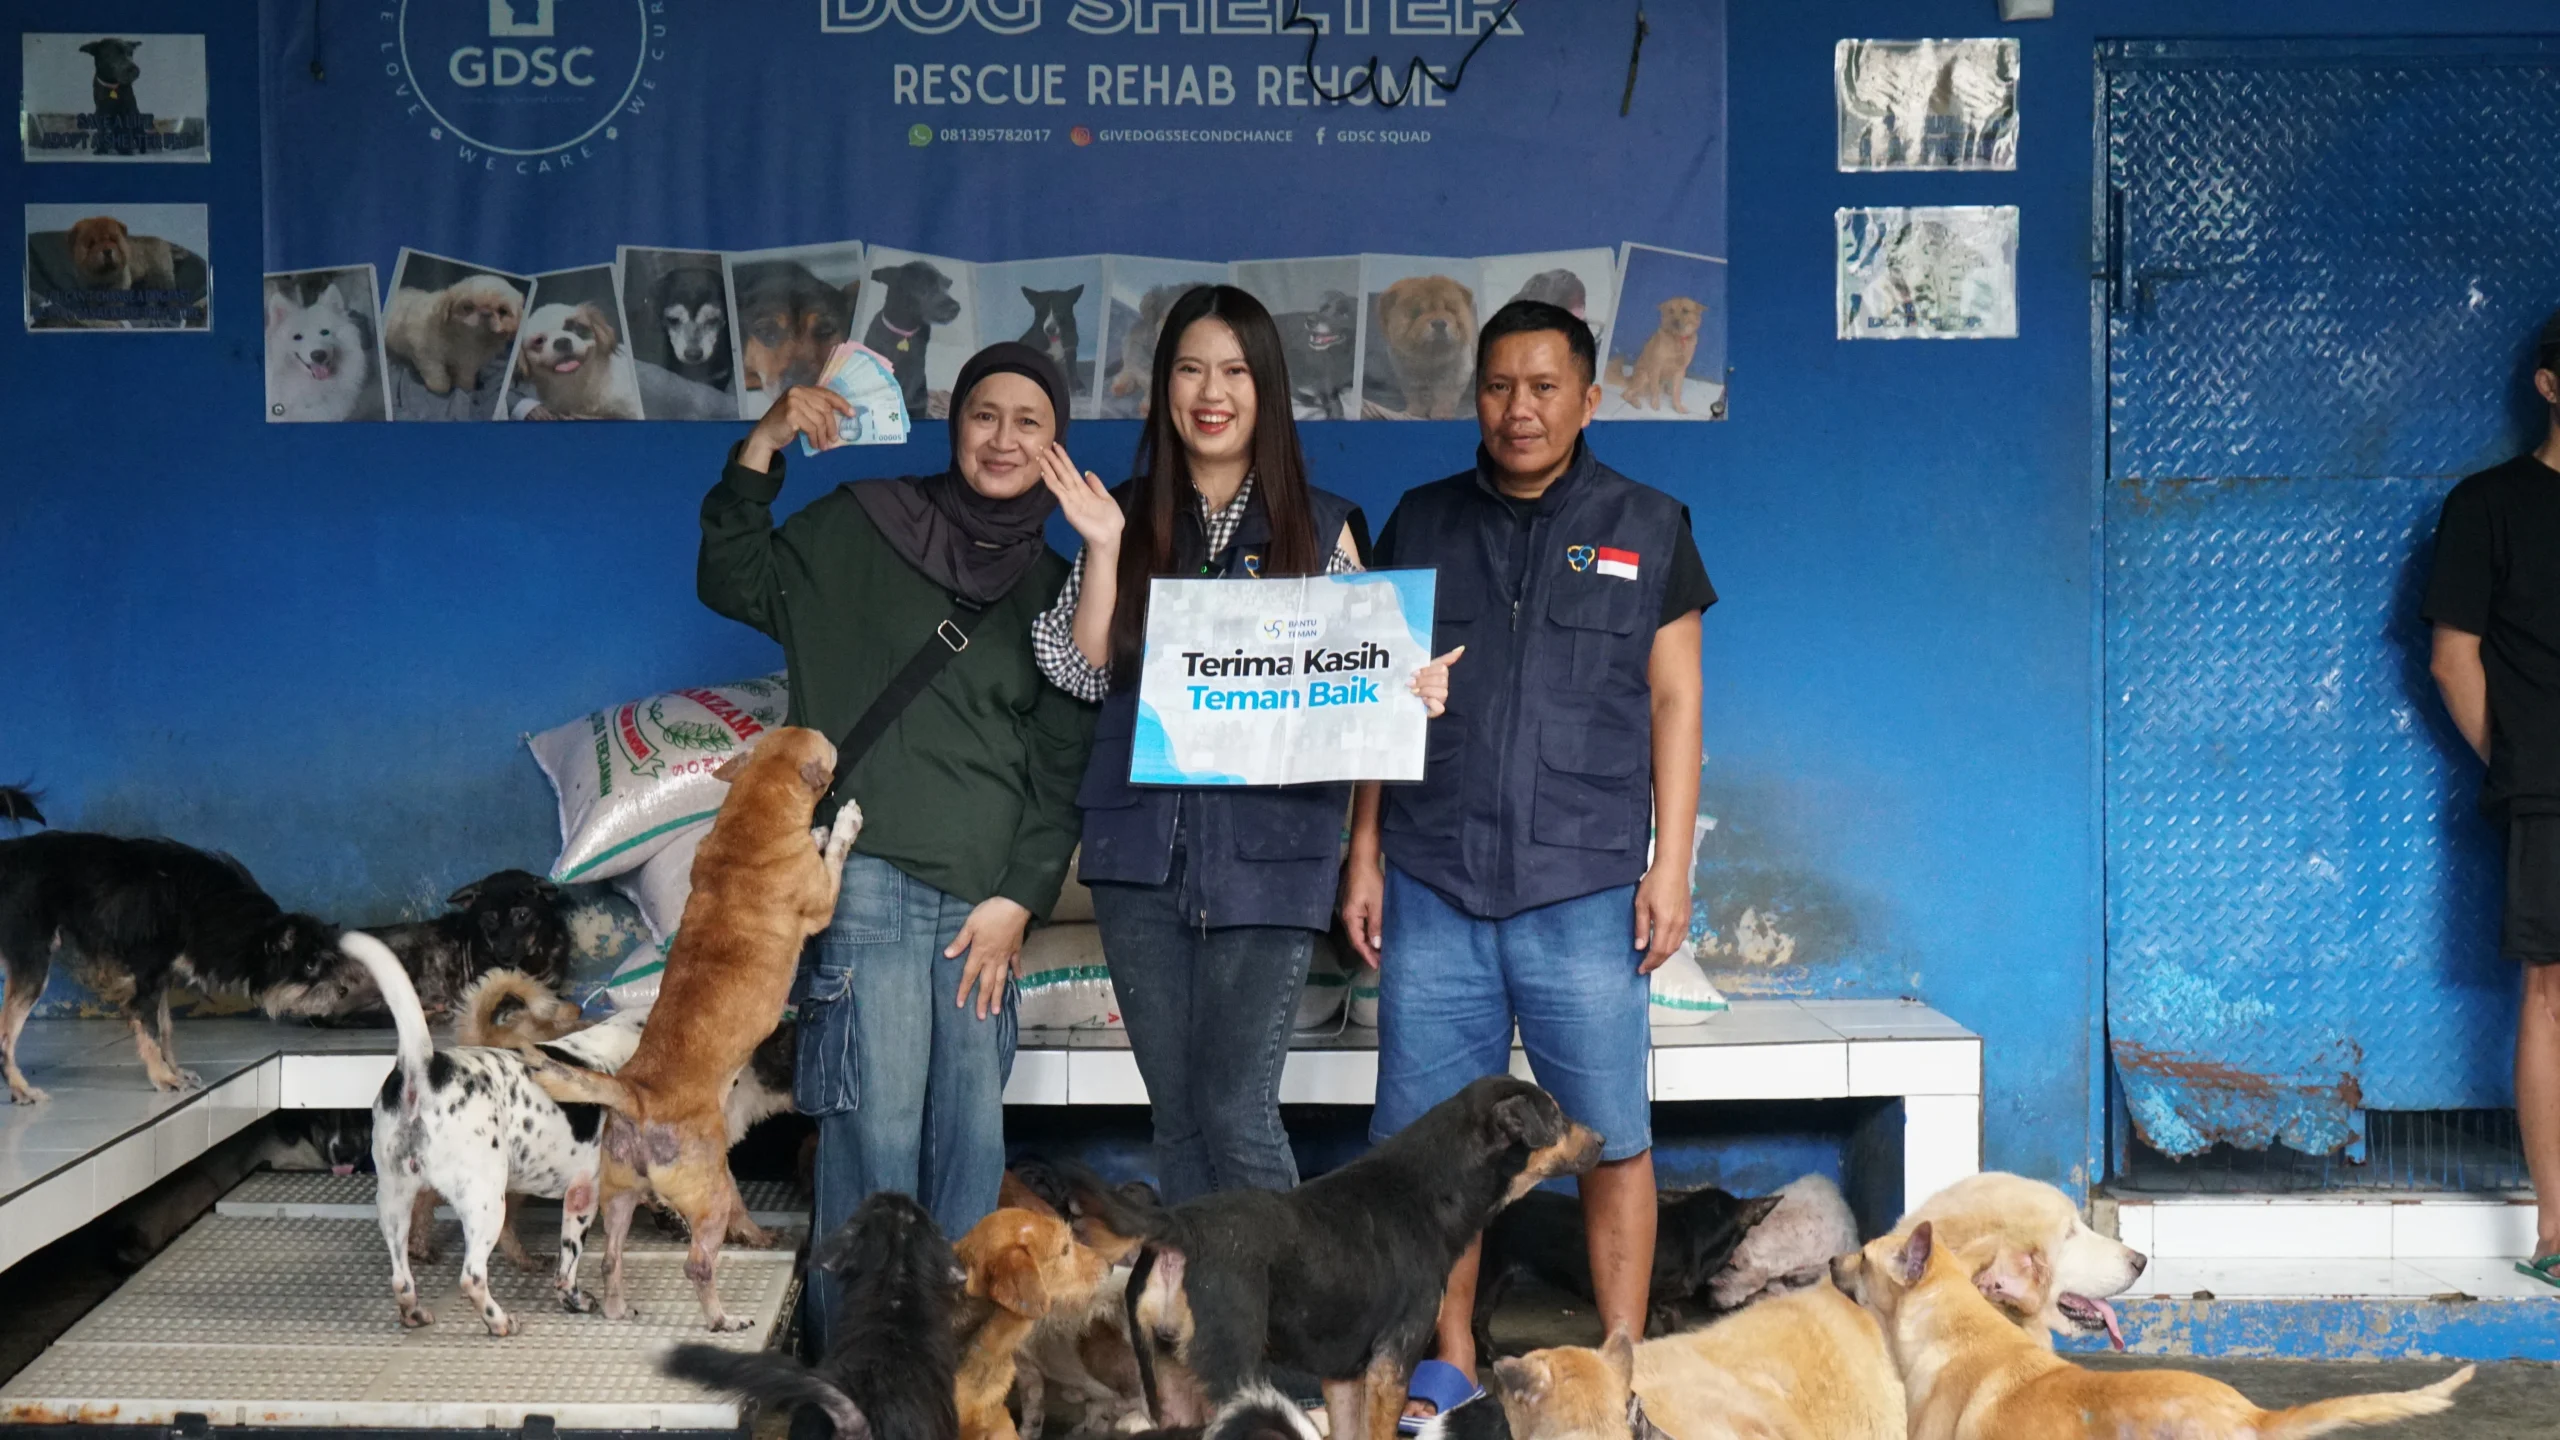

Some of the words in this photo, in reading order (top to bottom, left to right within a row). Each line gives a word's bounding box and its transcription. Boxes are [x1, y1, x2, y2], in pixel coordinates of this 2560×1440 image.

[821, 0, 1041, 34] DOG
[1067, 0, 1525, 35] SHELTER
[449, 46, 595, 87] GDSC
[894, 64, 1066, 105] RESCUE
[1088, 65, 1236, 106] REHAB
[1257, 65, 1447, 106] REHOME
[940, 129, 1051, 142] 081395782017
[1099, 130, 1293, 143] GIVEDOGSSECONDCHANCE
[1337, 130, 1375, 143] GDSC
[1379, 130, 1431, 144] SQUAD
[516, 146, 593, 175] CARE
[1182, 649, 1293, 677] Terima
[1303, 642, 1390, 675] Kasih
[1186, 685, 1300, 711] Teman
[1308, 676, 1379, 707] Baik
